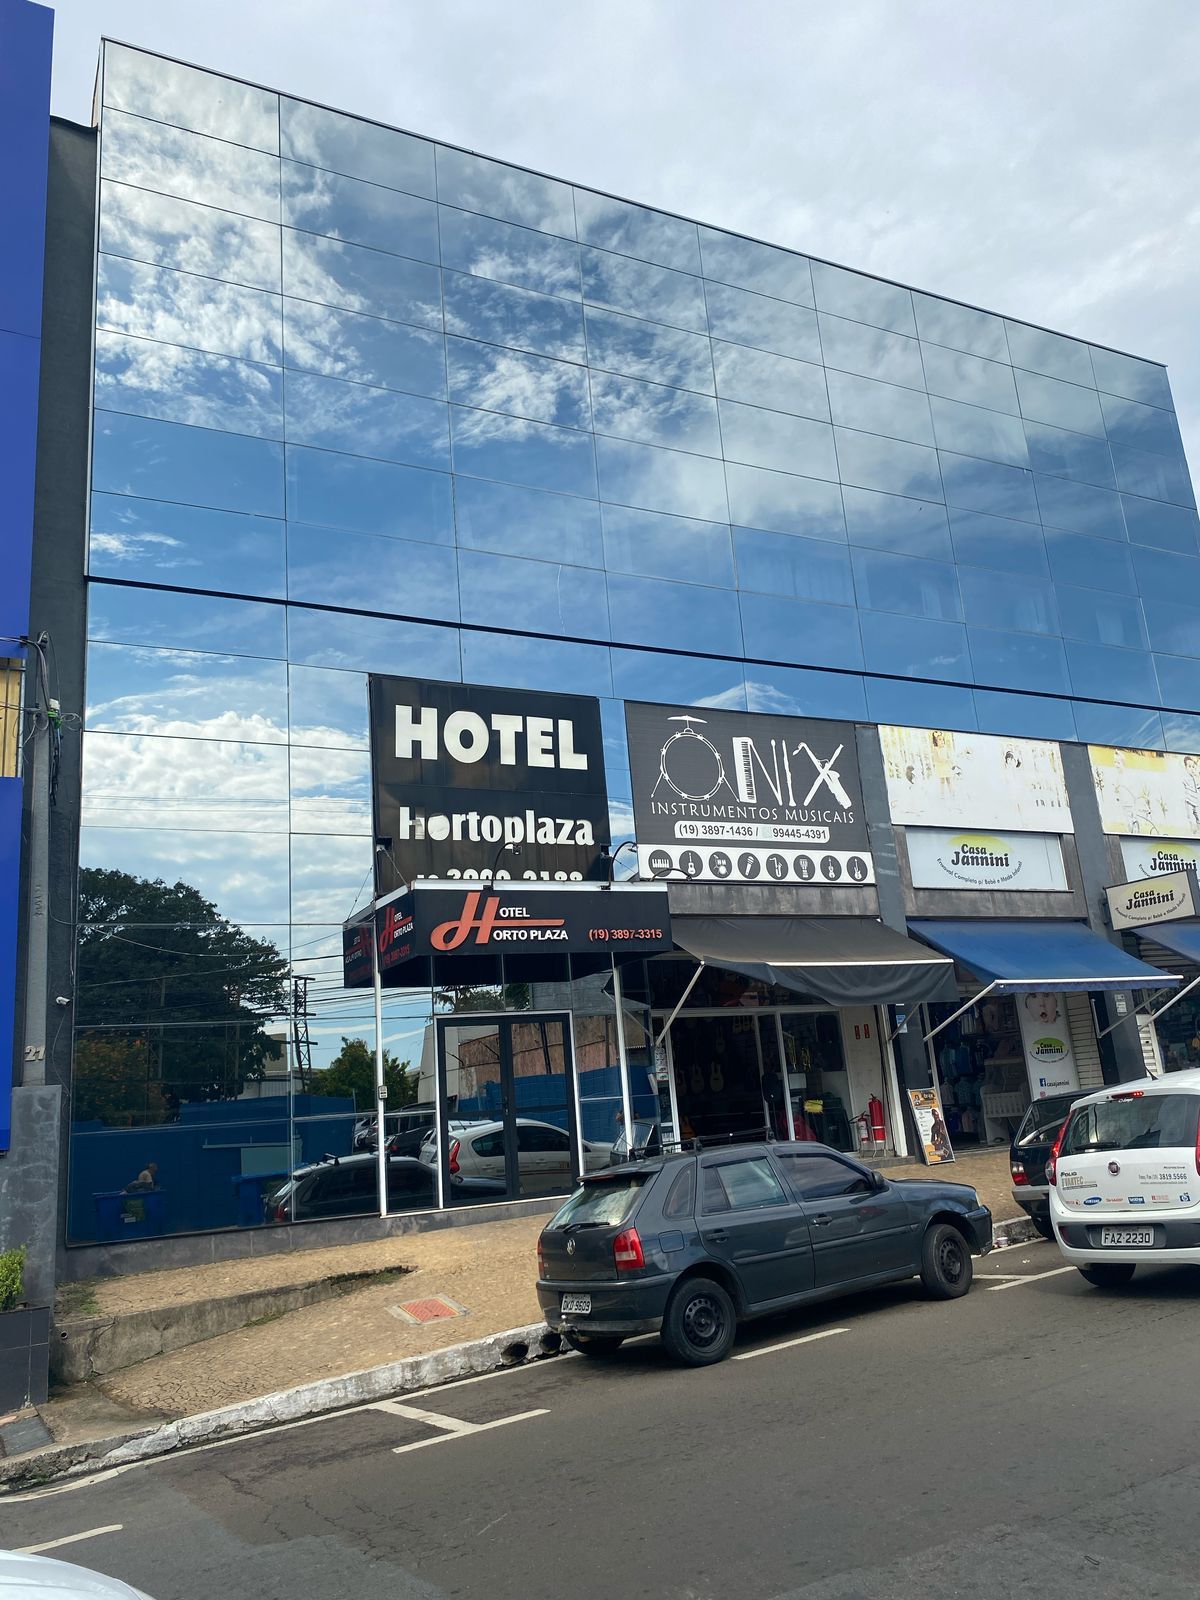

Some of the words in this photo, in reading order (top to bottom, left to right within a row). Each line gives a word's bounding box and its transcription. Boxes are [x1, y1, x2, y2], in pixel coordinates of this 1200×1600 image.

[395, 704, 588, 771] HOTEL
[651, 801, 779, 820] INSTRUMENTOS
[785, 808, 855, 824] MUSICAIS
[399, 806, 595, 850] Hortoplaza
[679, 825, 699, 837] (19)
[702, 825, 754, 837] 3897-1436
[773, 828, 827, 840] 99445-4391
[961, 843, 987, 855] Casa
[1157, 850, 1179, 861] Casa
[951, 851, 1010, 867] Jannini
[1150, 857, 1198, 872] Jannini
[1126, 889, 1175, 910] Jannini
[1133, 889, 1155, 900] Casa
[530, 929, 569, 940] PLAZA
[588, 928, 609, 942] (19)
[611, 928, 663, 940] 3897-3315
[1035, 1046, 1063, 1055] Jannini
